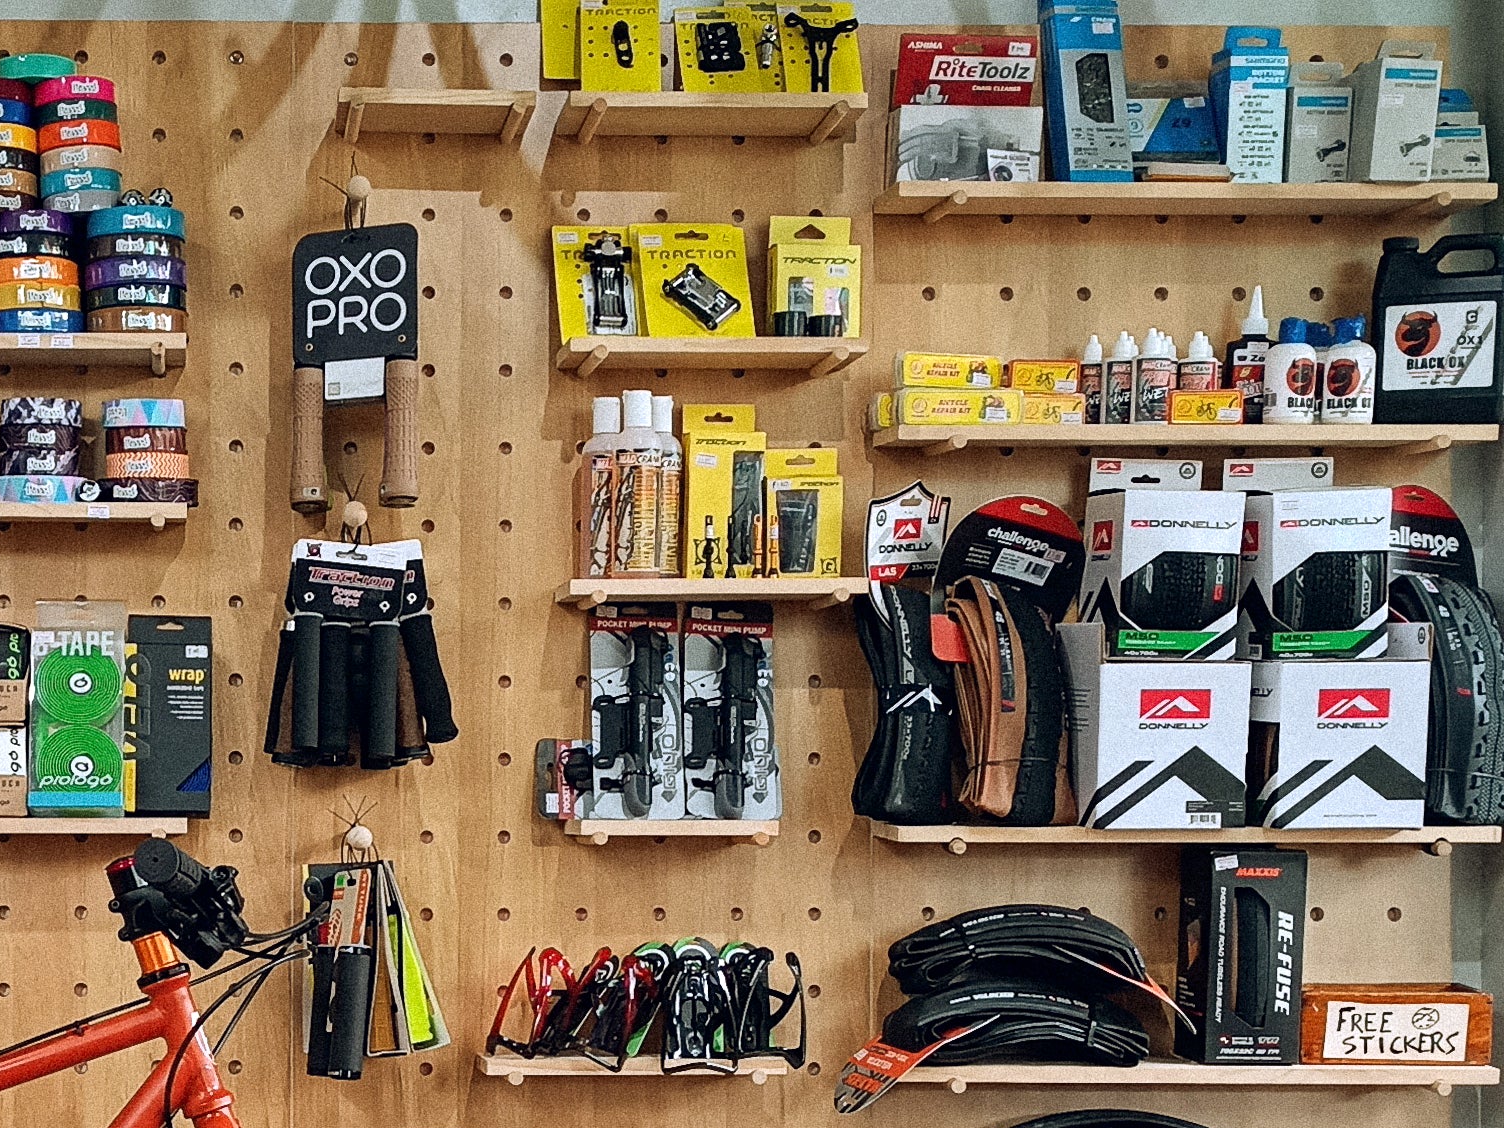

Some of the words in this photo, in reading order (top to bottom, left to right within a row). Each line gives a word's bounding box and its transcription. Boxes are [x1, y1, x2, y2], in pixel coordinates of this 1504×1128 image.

[586, 7, 657, 17] TRACTION
[907, 41, 943, 50] ASHIMA
[934, 58, 1031, 80] RiteToolz
[647, 249, 737, 260] TRACTION
[782, 256, 857, 265] TRACTION
[304, 248, 407, 296] OXO
[307, 291, 407, 339] PRO
[1406, 357, 1444, 371] BLACK
[1149, 519, 1237, 530] DONNELLY
[1298, 516, 1385, 527] DONNELLY
[878, 541, 932, 554] DONNELLY
[1389, 526, 1460, 558] allenge
[877, 566, 898, 578] LAS
[1361, 578, 1372, 616] MSO
[597, 619, 627, 629] POCKET
[692, 623, 722, 633] POCKET
[744, 626, 767, 635] PUMP
[1125, 632, 1160, 641] MSO
[1279, 634, 1314, 643] MSO
[169, 668, 205, 685] wrap
[124, 653, 152, 760] VELO
[1138, 721, 1209, 730] DONNELLY
[1317, 721, 1389, 730] DONNELLY
[38, 774, 114, 790] prologo
[1235, 867, 1283, 878] MAXXIS
[1218, 886, 1227, 935] ENDURANCE
[1217, 936, 1226, 957] ROAD
[1274, 911, 1294, 1016] RE-FUSE
[1215, 958, 1224, 997] TUBELESS
[1214, 997, 1223, 1024] READY
[1336, 1006, 1394, 1033] FREE
[1341, 1031, 1460, 1055] STICKERS
